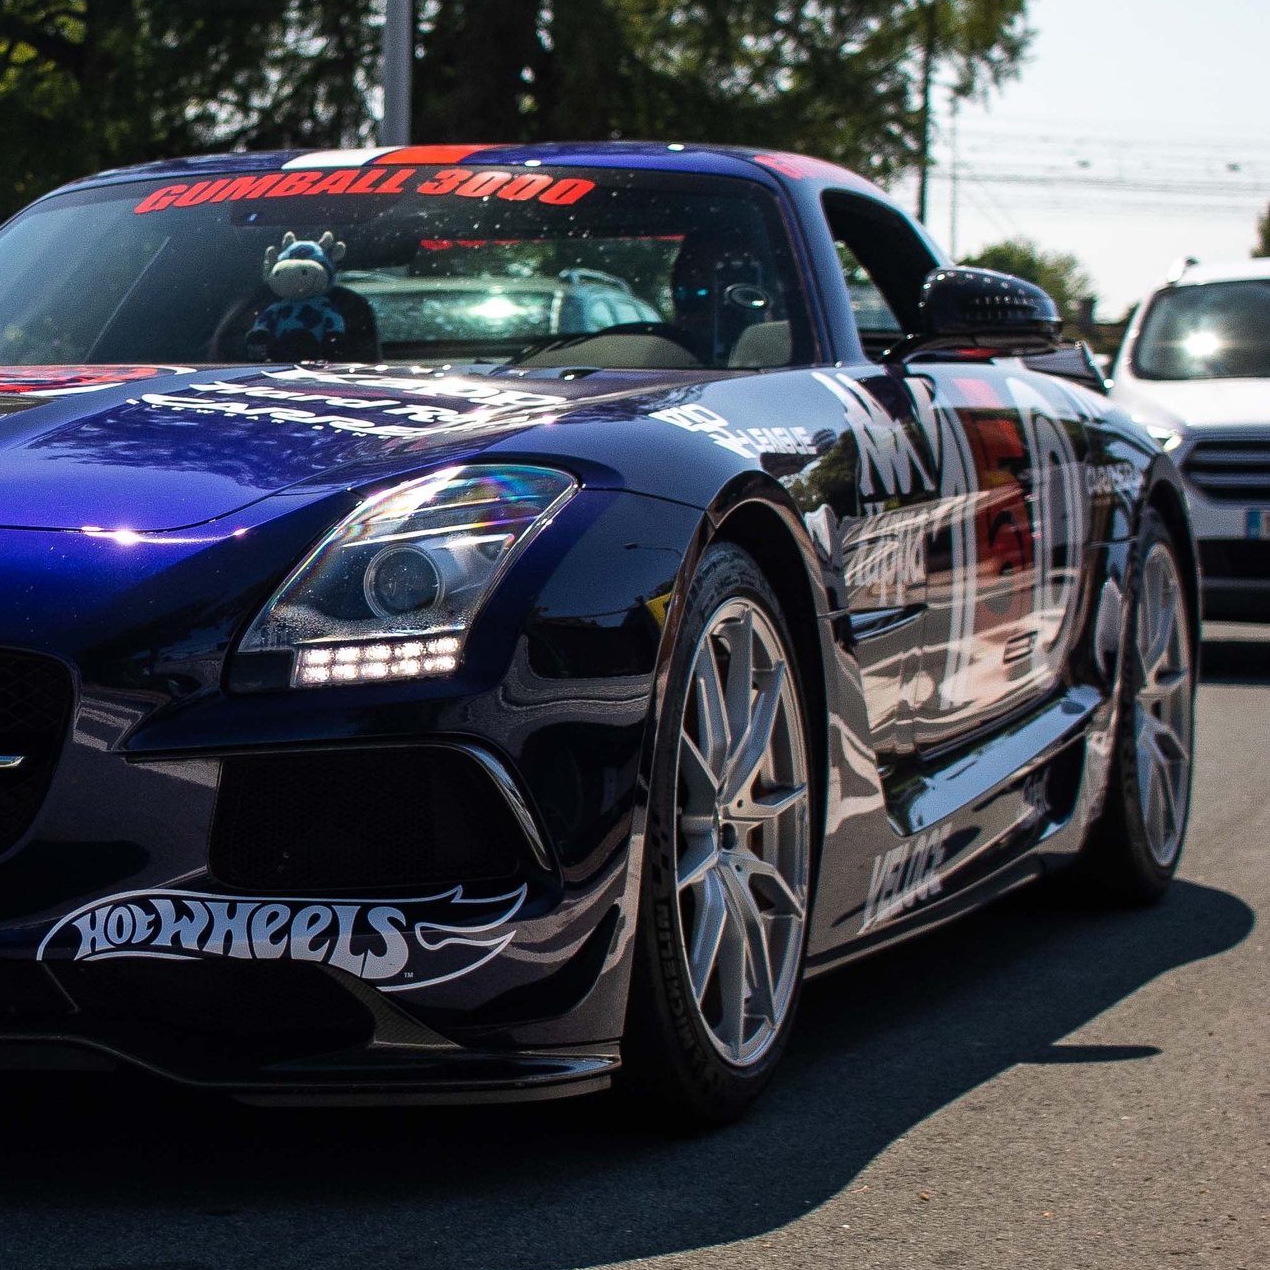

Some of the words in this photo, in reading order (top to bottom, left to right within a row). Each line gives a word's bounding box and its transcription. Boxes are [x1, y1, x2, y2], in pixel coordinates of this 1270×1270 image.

[134, 168, 416, 215] GUMBALL
[417, 170, 596, 206] 3000
[189, 380, 401, 409] Hard
[261, 364, 568, 407] Kapp
[147, 898, 410, 979] WHEELS
[654, 902, 696, 1052] MICHELIN
